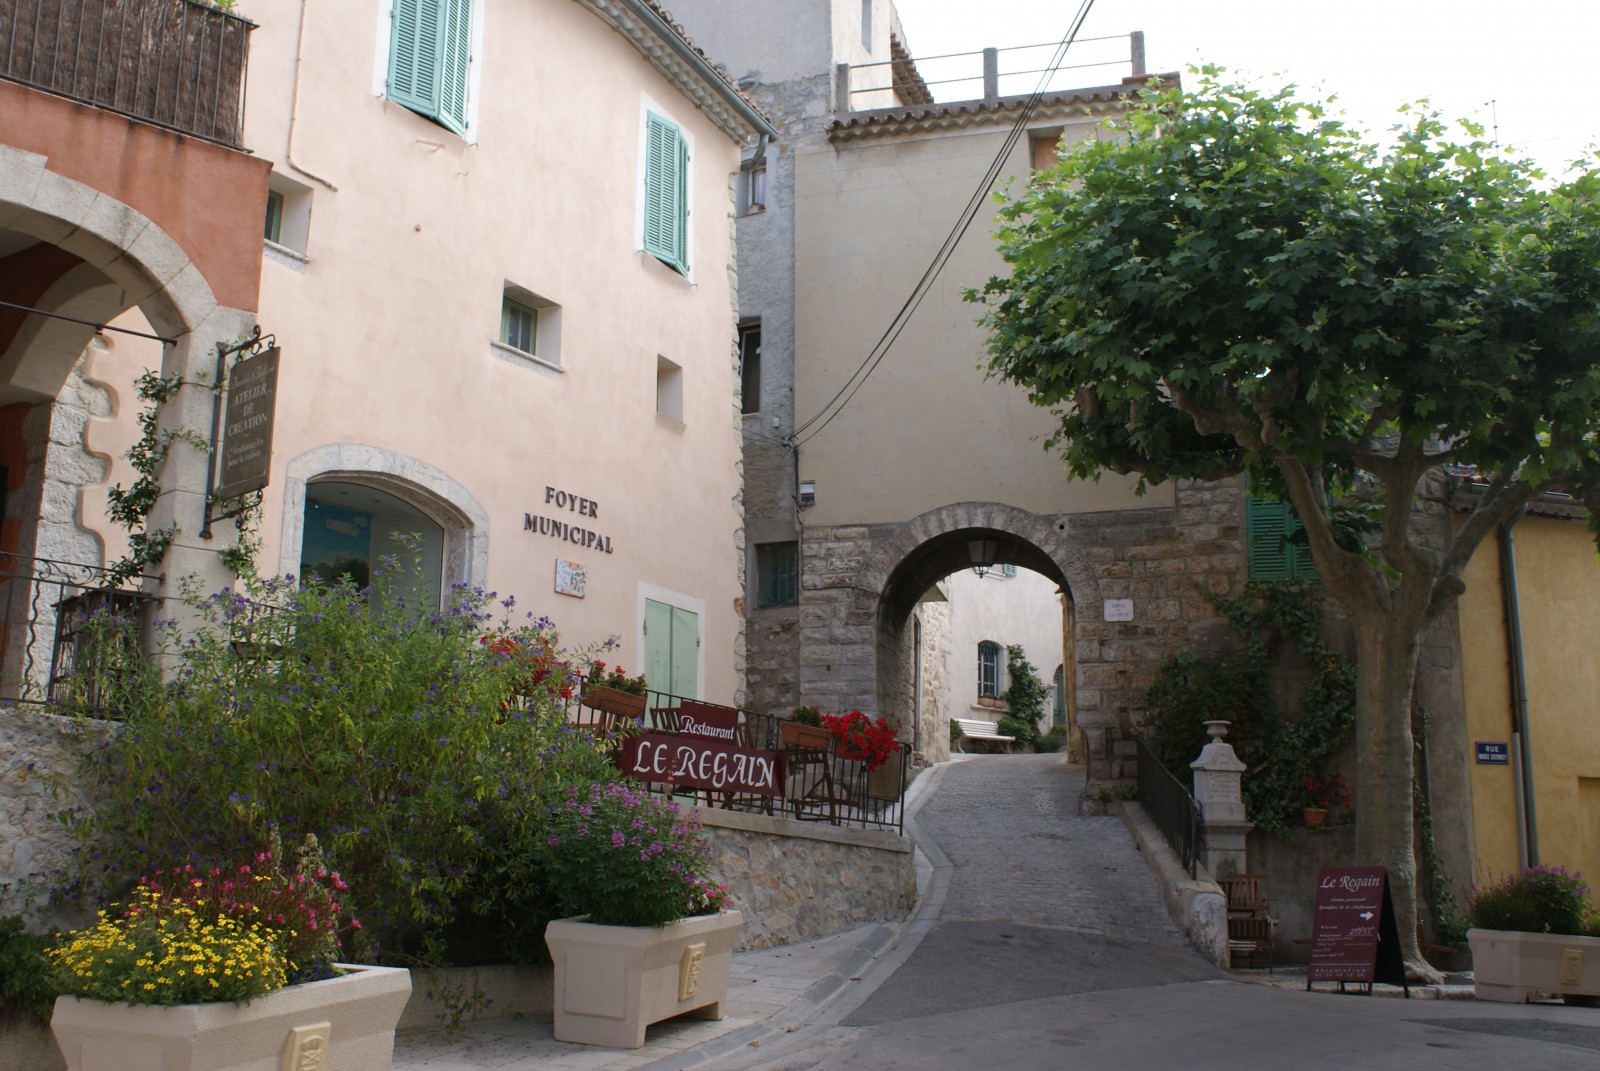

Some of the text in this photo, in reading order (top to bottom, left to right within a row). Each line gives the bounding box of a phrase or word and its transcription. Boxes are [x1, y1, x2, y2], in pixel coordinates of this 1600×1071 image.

[234, 383, 268, 405] ATELIER
[242, 403, 255, 418] DE
[228, 412, 267, 436] CREATION
[545, 486, 598, 518] FOYER
[524, 513, 613, 554] MUNICIPAL
[679, 715, 735, 740] Restaurant
[633, 741, 774, 789] LE REGAIN
[1320, 875, 1380, 892] Le Regain
